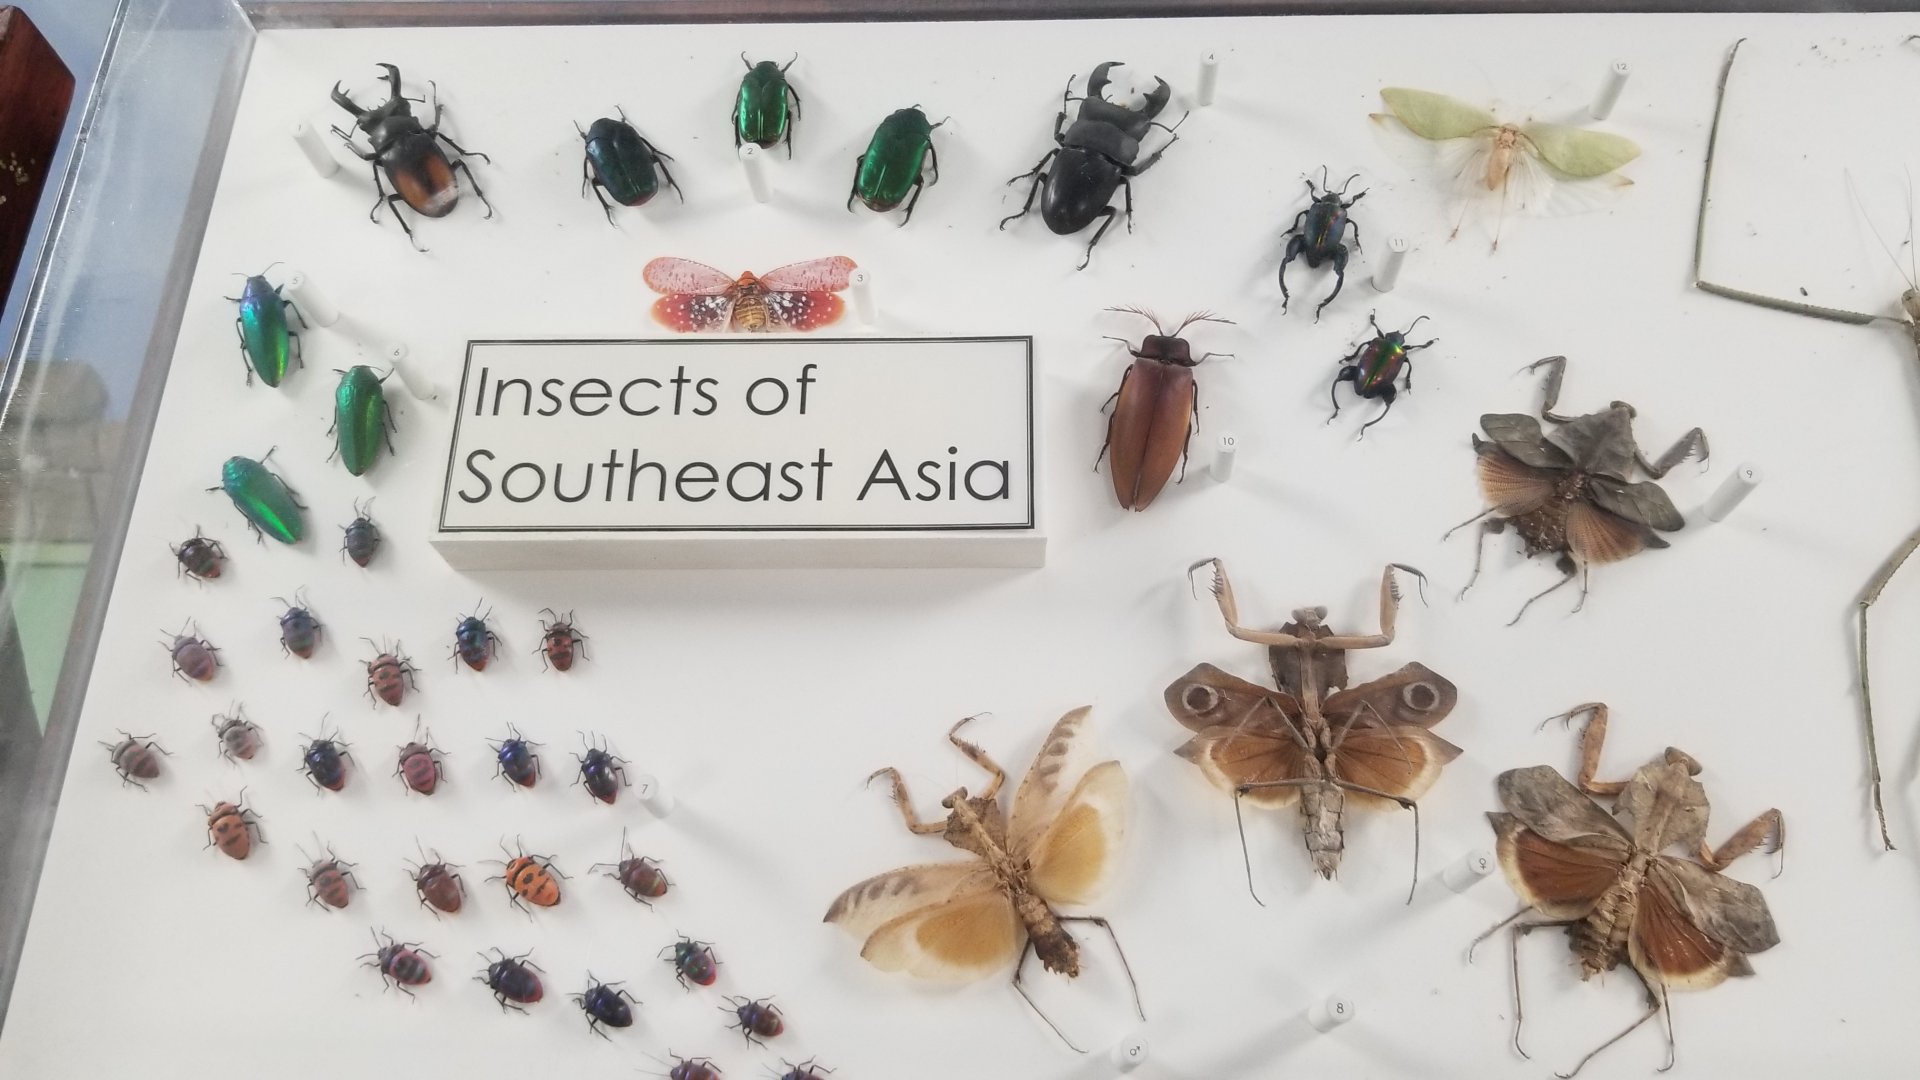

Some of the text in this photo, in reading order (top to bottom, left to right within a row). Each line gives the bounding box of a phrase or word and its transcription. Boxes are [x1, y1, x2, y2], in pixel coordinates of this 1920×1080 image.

[1208, 53, 1214, 61] 4
[1616, 63, 1627, 71] 12
[747, 147, 753, 155] 2
[1394, 238, 1404, 247] 11
[857, 274, 864, 282] 3
[393, 348, 400, 356] 6
[474, 363, 818, 416] Insects of
[1222, 437, 1234, 446] 10
[458, 446, 1011, 503] Southeast Asia
[1746, 469, 1753, 479] 9
[641, 784, 648, 794] 7
[1336, 1002, 1344, 1013] 8
